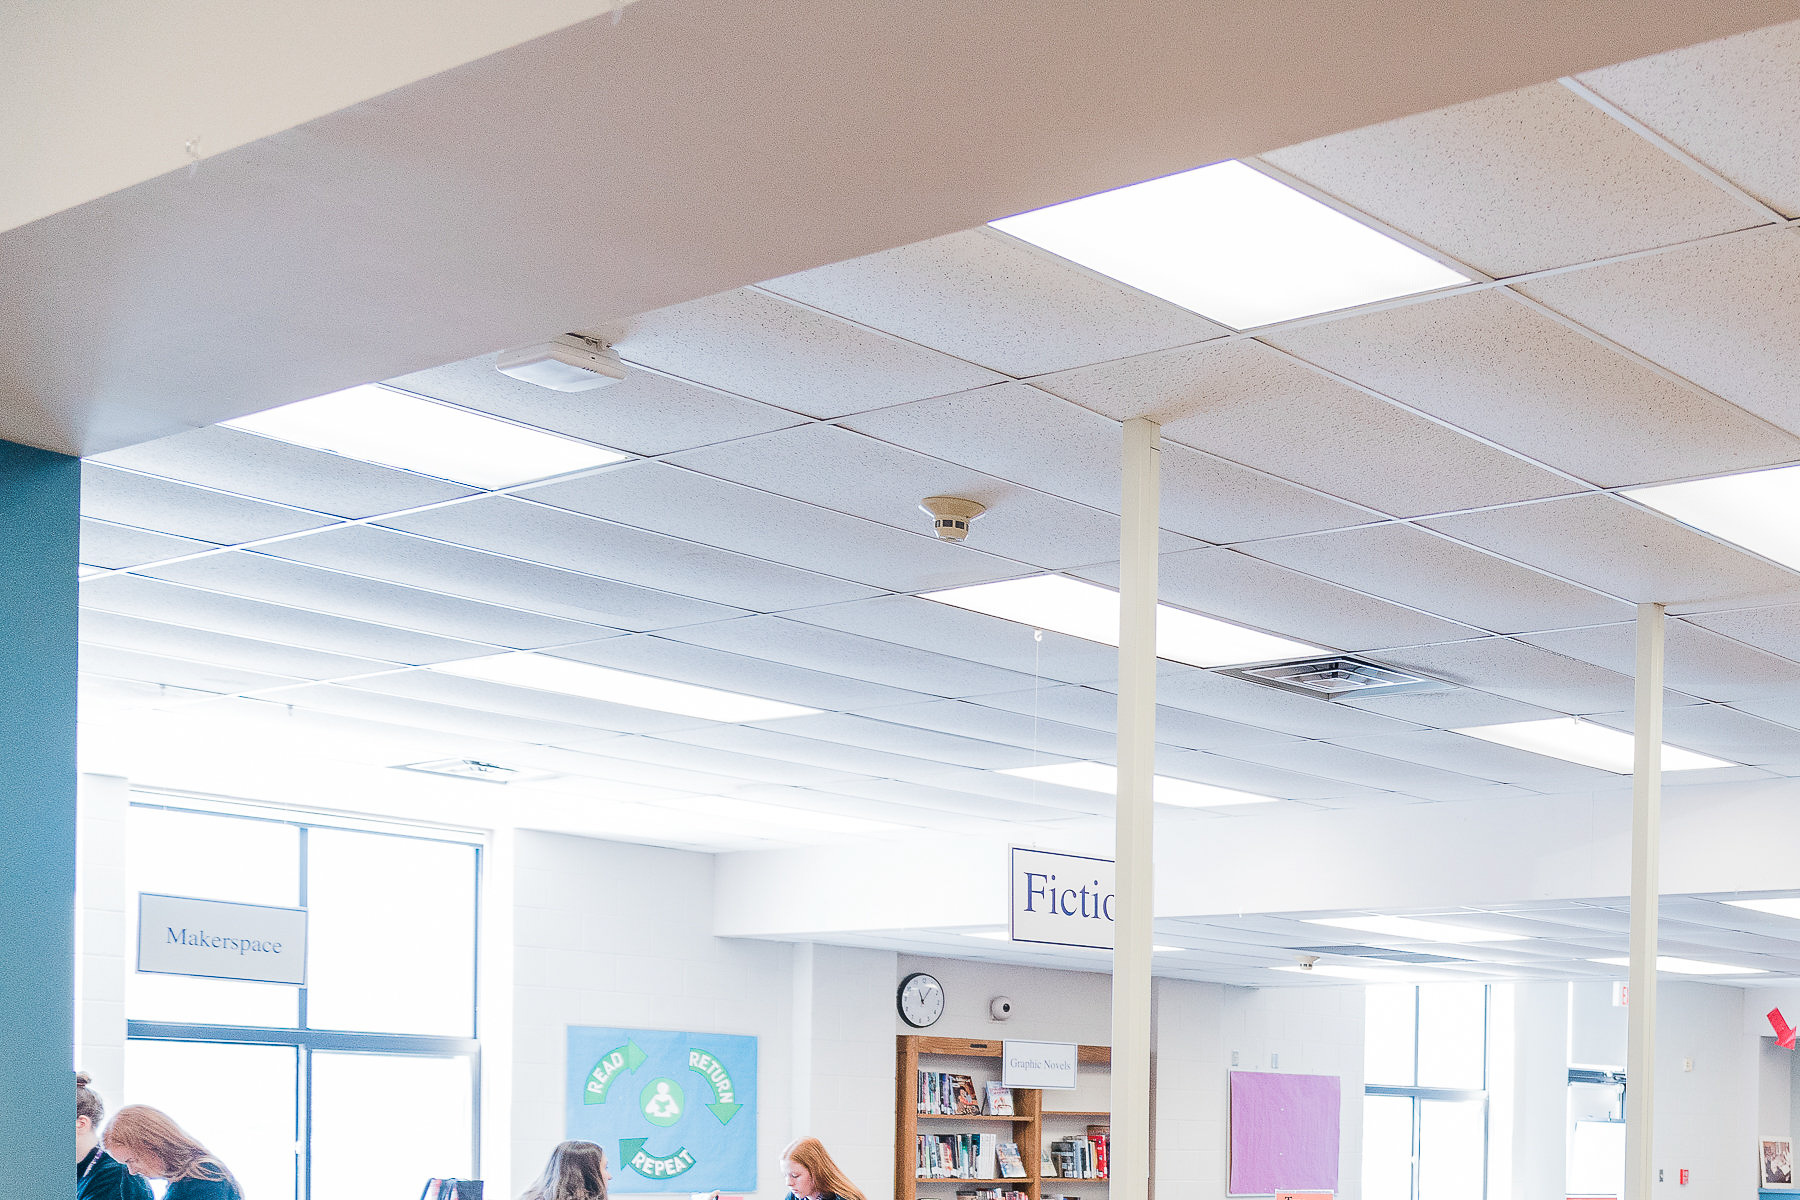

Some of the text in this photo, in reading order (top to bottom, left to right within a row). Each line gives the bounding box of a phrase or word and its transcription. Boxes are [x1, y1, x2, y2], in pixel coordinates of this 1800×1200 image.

[1024, 872, 1115, 922] Fictio
[166, 927, 283, 955] Makerspace
[587, 1052, 624, 1094] READ
[689, 1051, 734, 1104] RETURN
[1010, 1058, 1072, 1071] Graphic Novels
[631, 1149, 694, 1176] REPEAT
